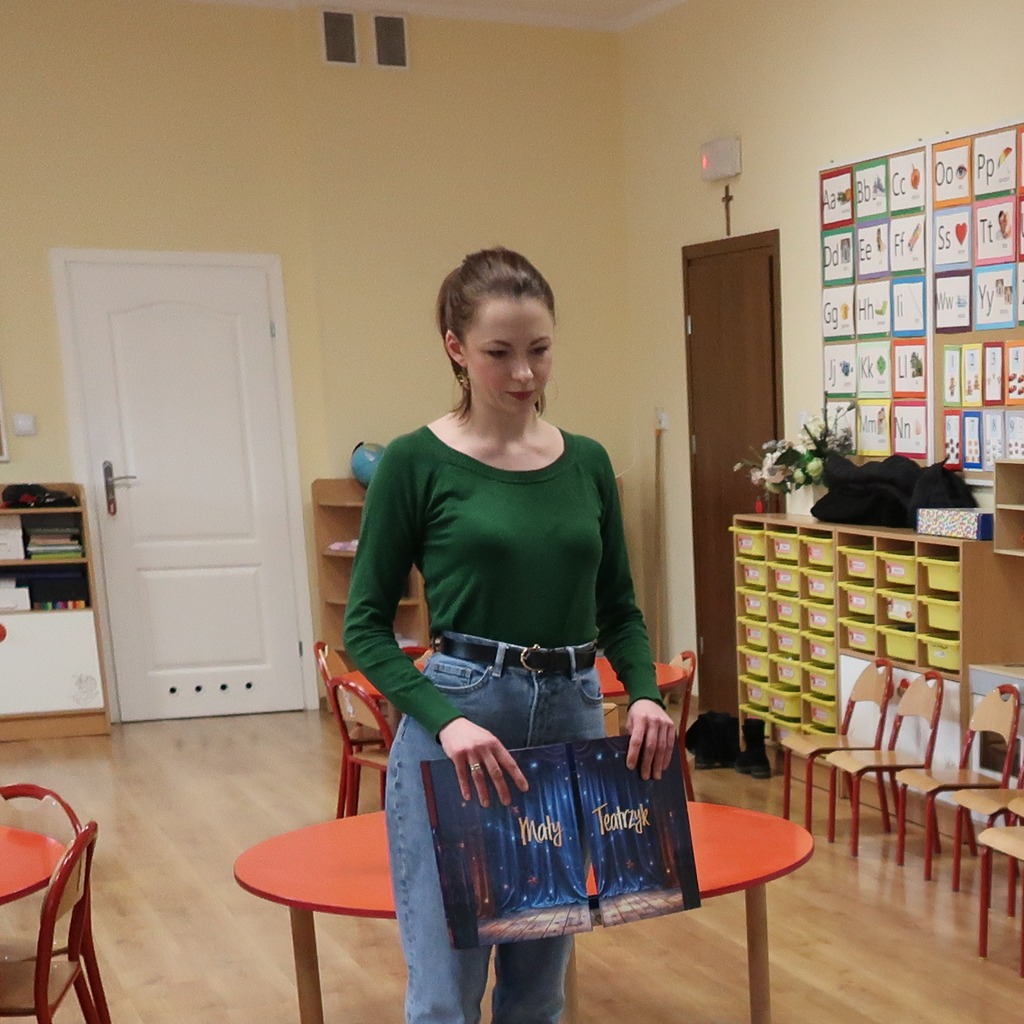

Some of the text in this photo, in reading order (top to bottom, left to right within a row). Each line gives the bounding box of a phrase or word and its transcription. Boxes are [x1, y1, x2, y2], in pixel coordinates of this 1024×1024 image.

[935, 161, 953, 186] Oo
[977, 153, 995, 186] Pp
[858, 179, 871, 203] Bb
[892, 172, 906, 196] Cc
[824, 189, 836, 210] Aa
[938, 225, 951, 250] Ss
[979, 218, 993, 243] Tt
[824, 243, 839, 267] Dd
[860, 239, 872, 261] Ee
[894, 231, 906, 256] Ff
[858, 297, 874, 321] Hh
[978, 284, 994, 317] Yy
[823, 302, 838, 330] Gg
[861, 356, 874, 379] Kk
[894, 417, 911, 439] Nn
[592, 803, 651, 835] Teatrzyk
